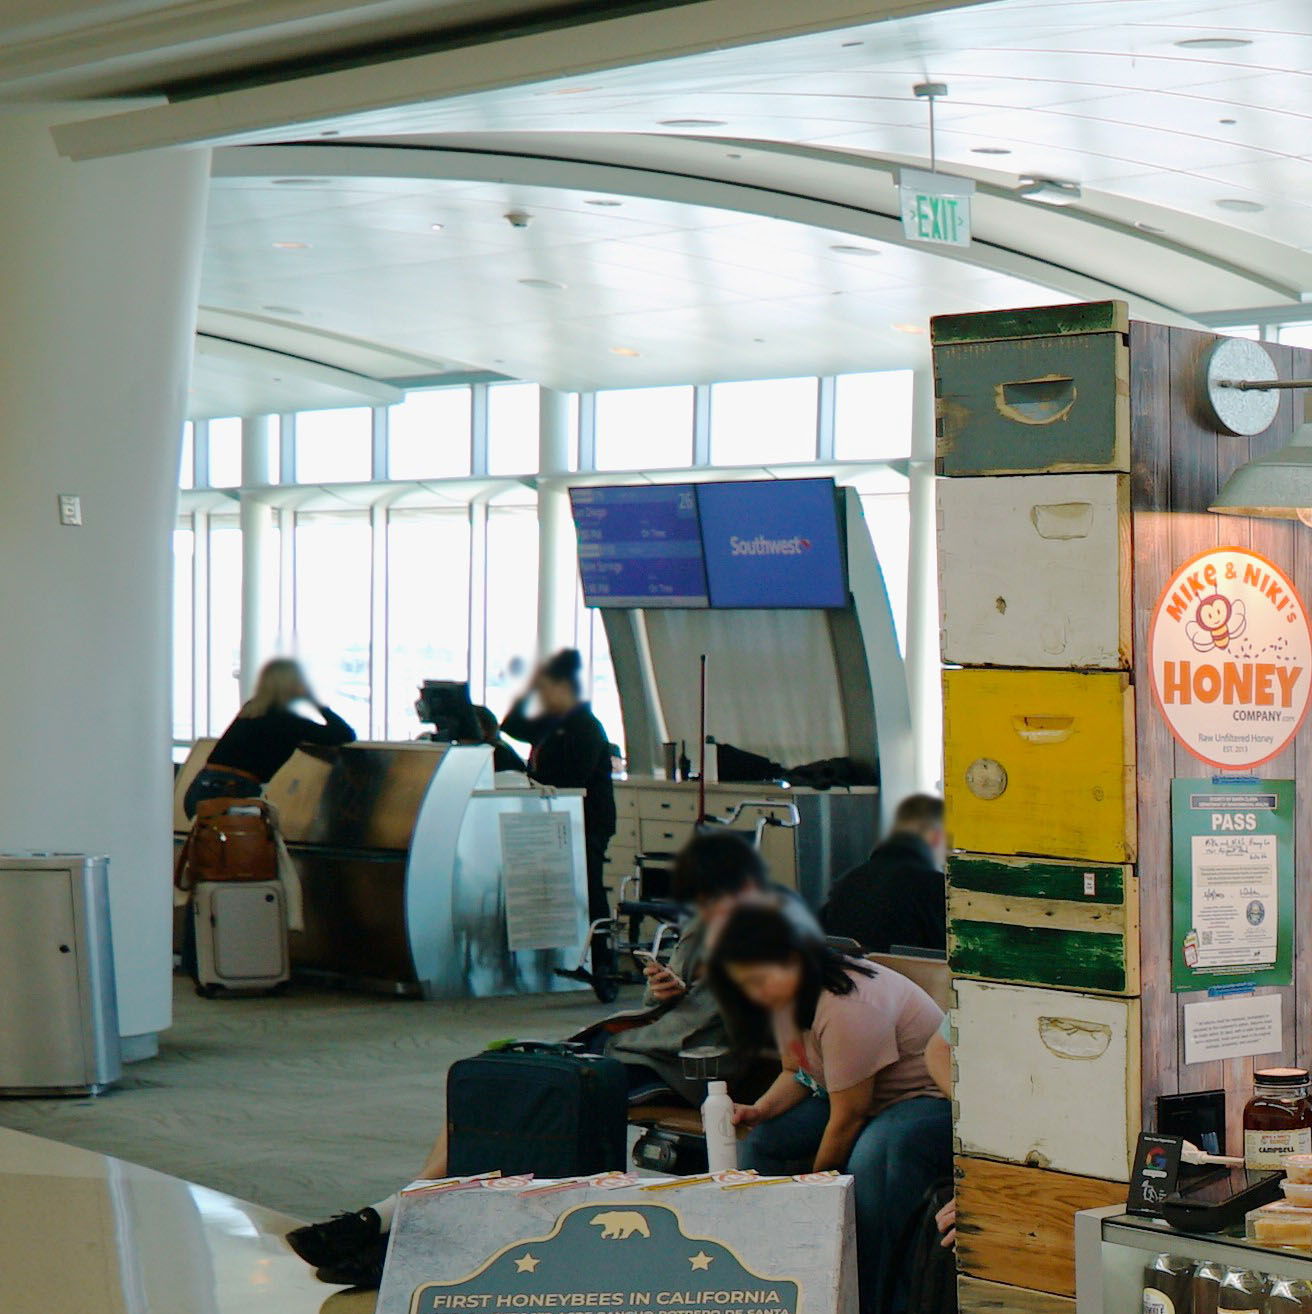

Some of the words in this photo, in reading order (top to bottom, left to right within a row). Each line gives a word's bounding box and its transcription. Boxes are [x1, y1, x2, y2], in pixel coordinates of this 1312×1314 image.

[916, 195, 958, 241] EXIT
[729, 534, 801, 557] Southwest
[1224, 562, 1237, 580] &
[1163, 660, 1303, 708] HONEY
[1212, 813, 1257, 831] PASS
[433, 1294, 493, 1308] FIRST
[496, 1292, 624, 1308] HONEYBEES
[629, 1292, 651, 1305] IN
[655, 1290, 780, 1305] CALIFORNIA
